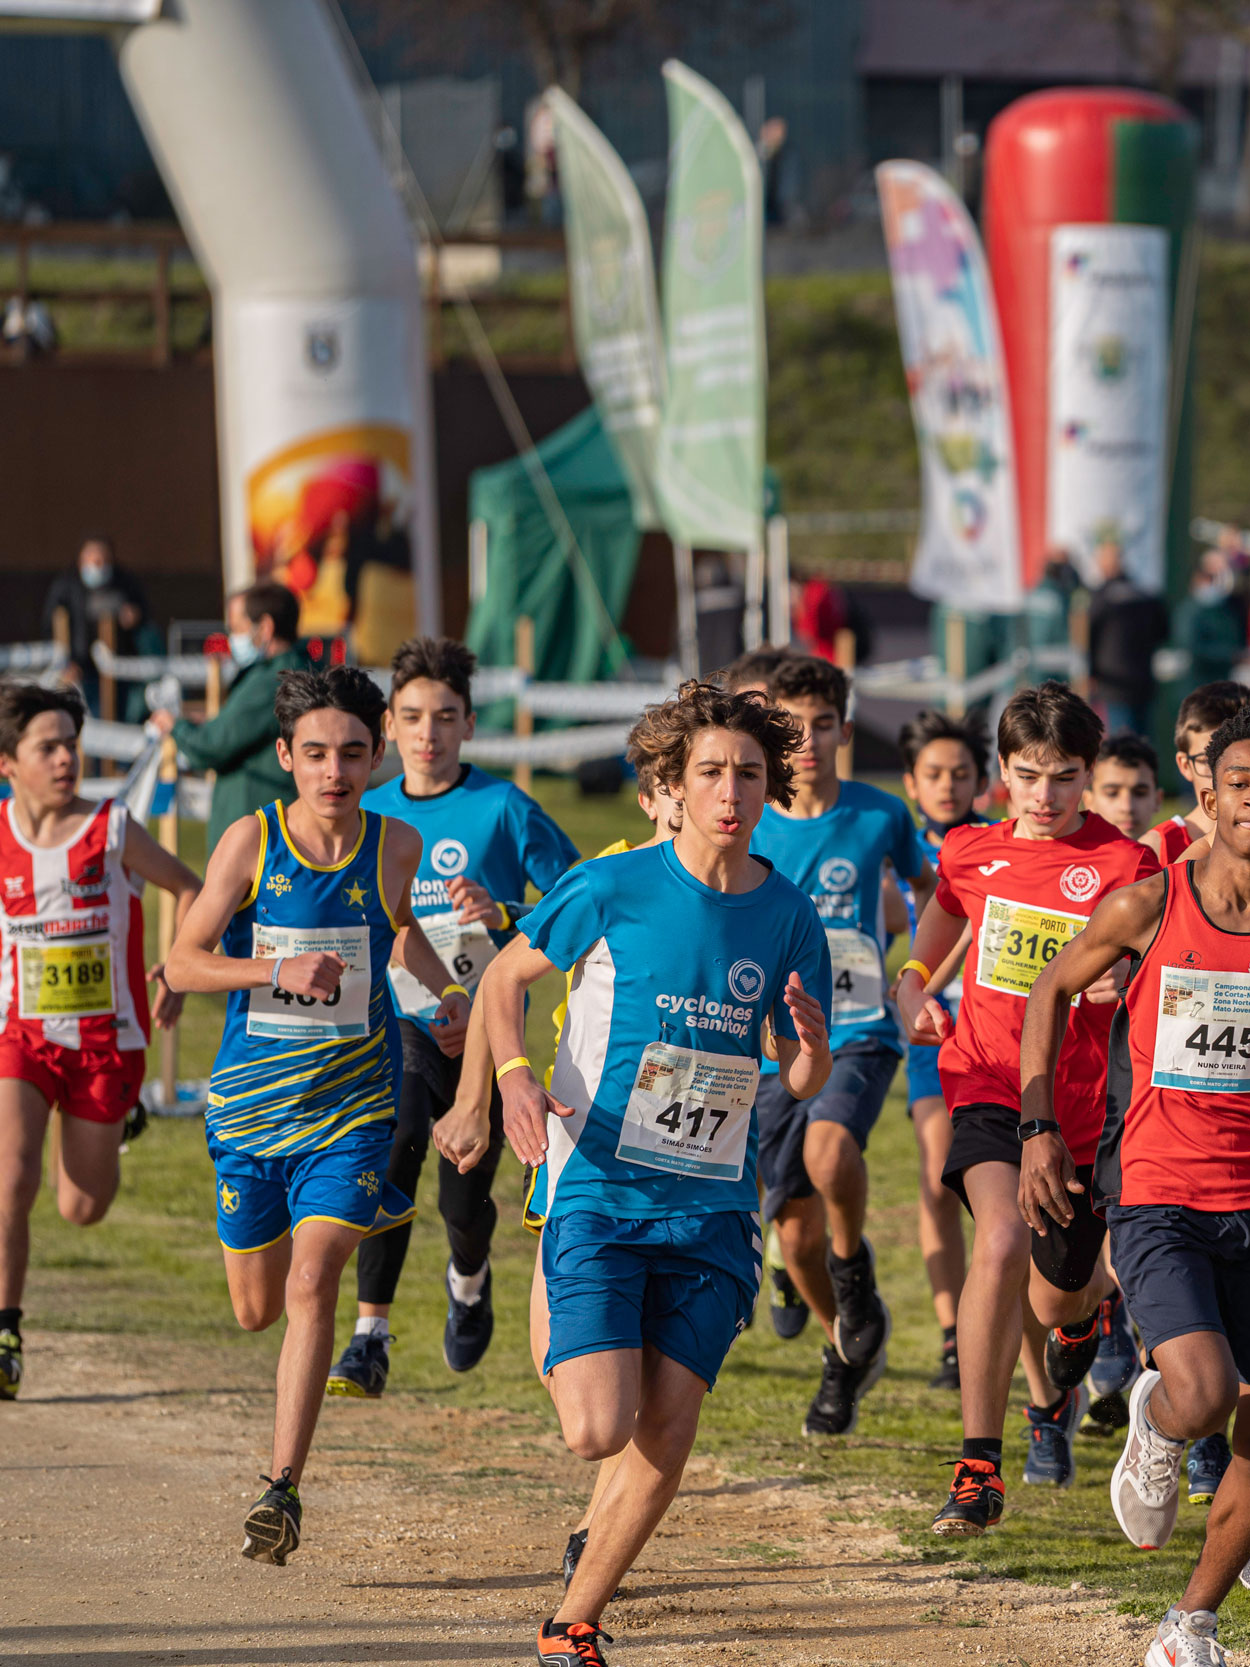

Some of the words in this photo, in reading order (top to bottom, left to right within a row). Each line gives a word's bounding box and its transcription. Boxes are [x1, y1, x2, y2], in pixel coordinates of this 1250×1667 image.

[265, 882, 293, 893] SPORT
[1040, 918, 1066, 934] PORTO
[336, 938, 362, 946] Regional
[1002, 958, 1038, 971] GUILHERME
[46, 962, 105, 986] 3189
[996, 975, 1034, 990] www.aap
[655, 994, 753, 1021] cyclones
[685, 1014, 749, 1038] sanitop
[696, 1064, 734, 1074] Campeonato
[734, 1068, 754, 1076] Regional
[1197, 1062, 1220, 1070] NUNO
[692, 1078, 708, 1086] Zona
[704, 1072, 735, 1082] Corta-Mato
[690, 1085, 708, 1094] Mato
[708, 1088, 726, 1096] Jovem
[655, 1101, 729, 1141] 417
[661, 1137, 684, 1149] SIMÃO
[686, 1142, 713, 1154] SIMÕES
